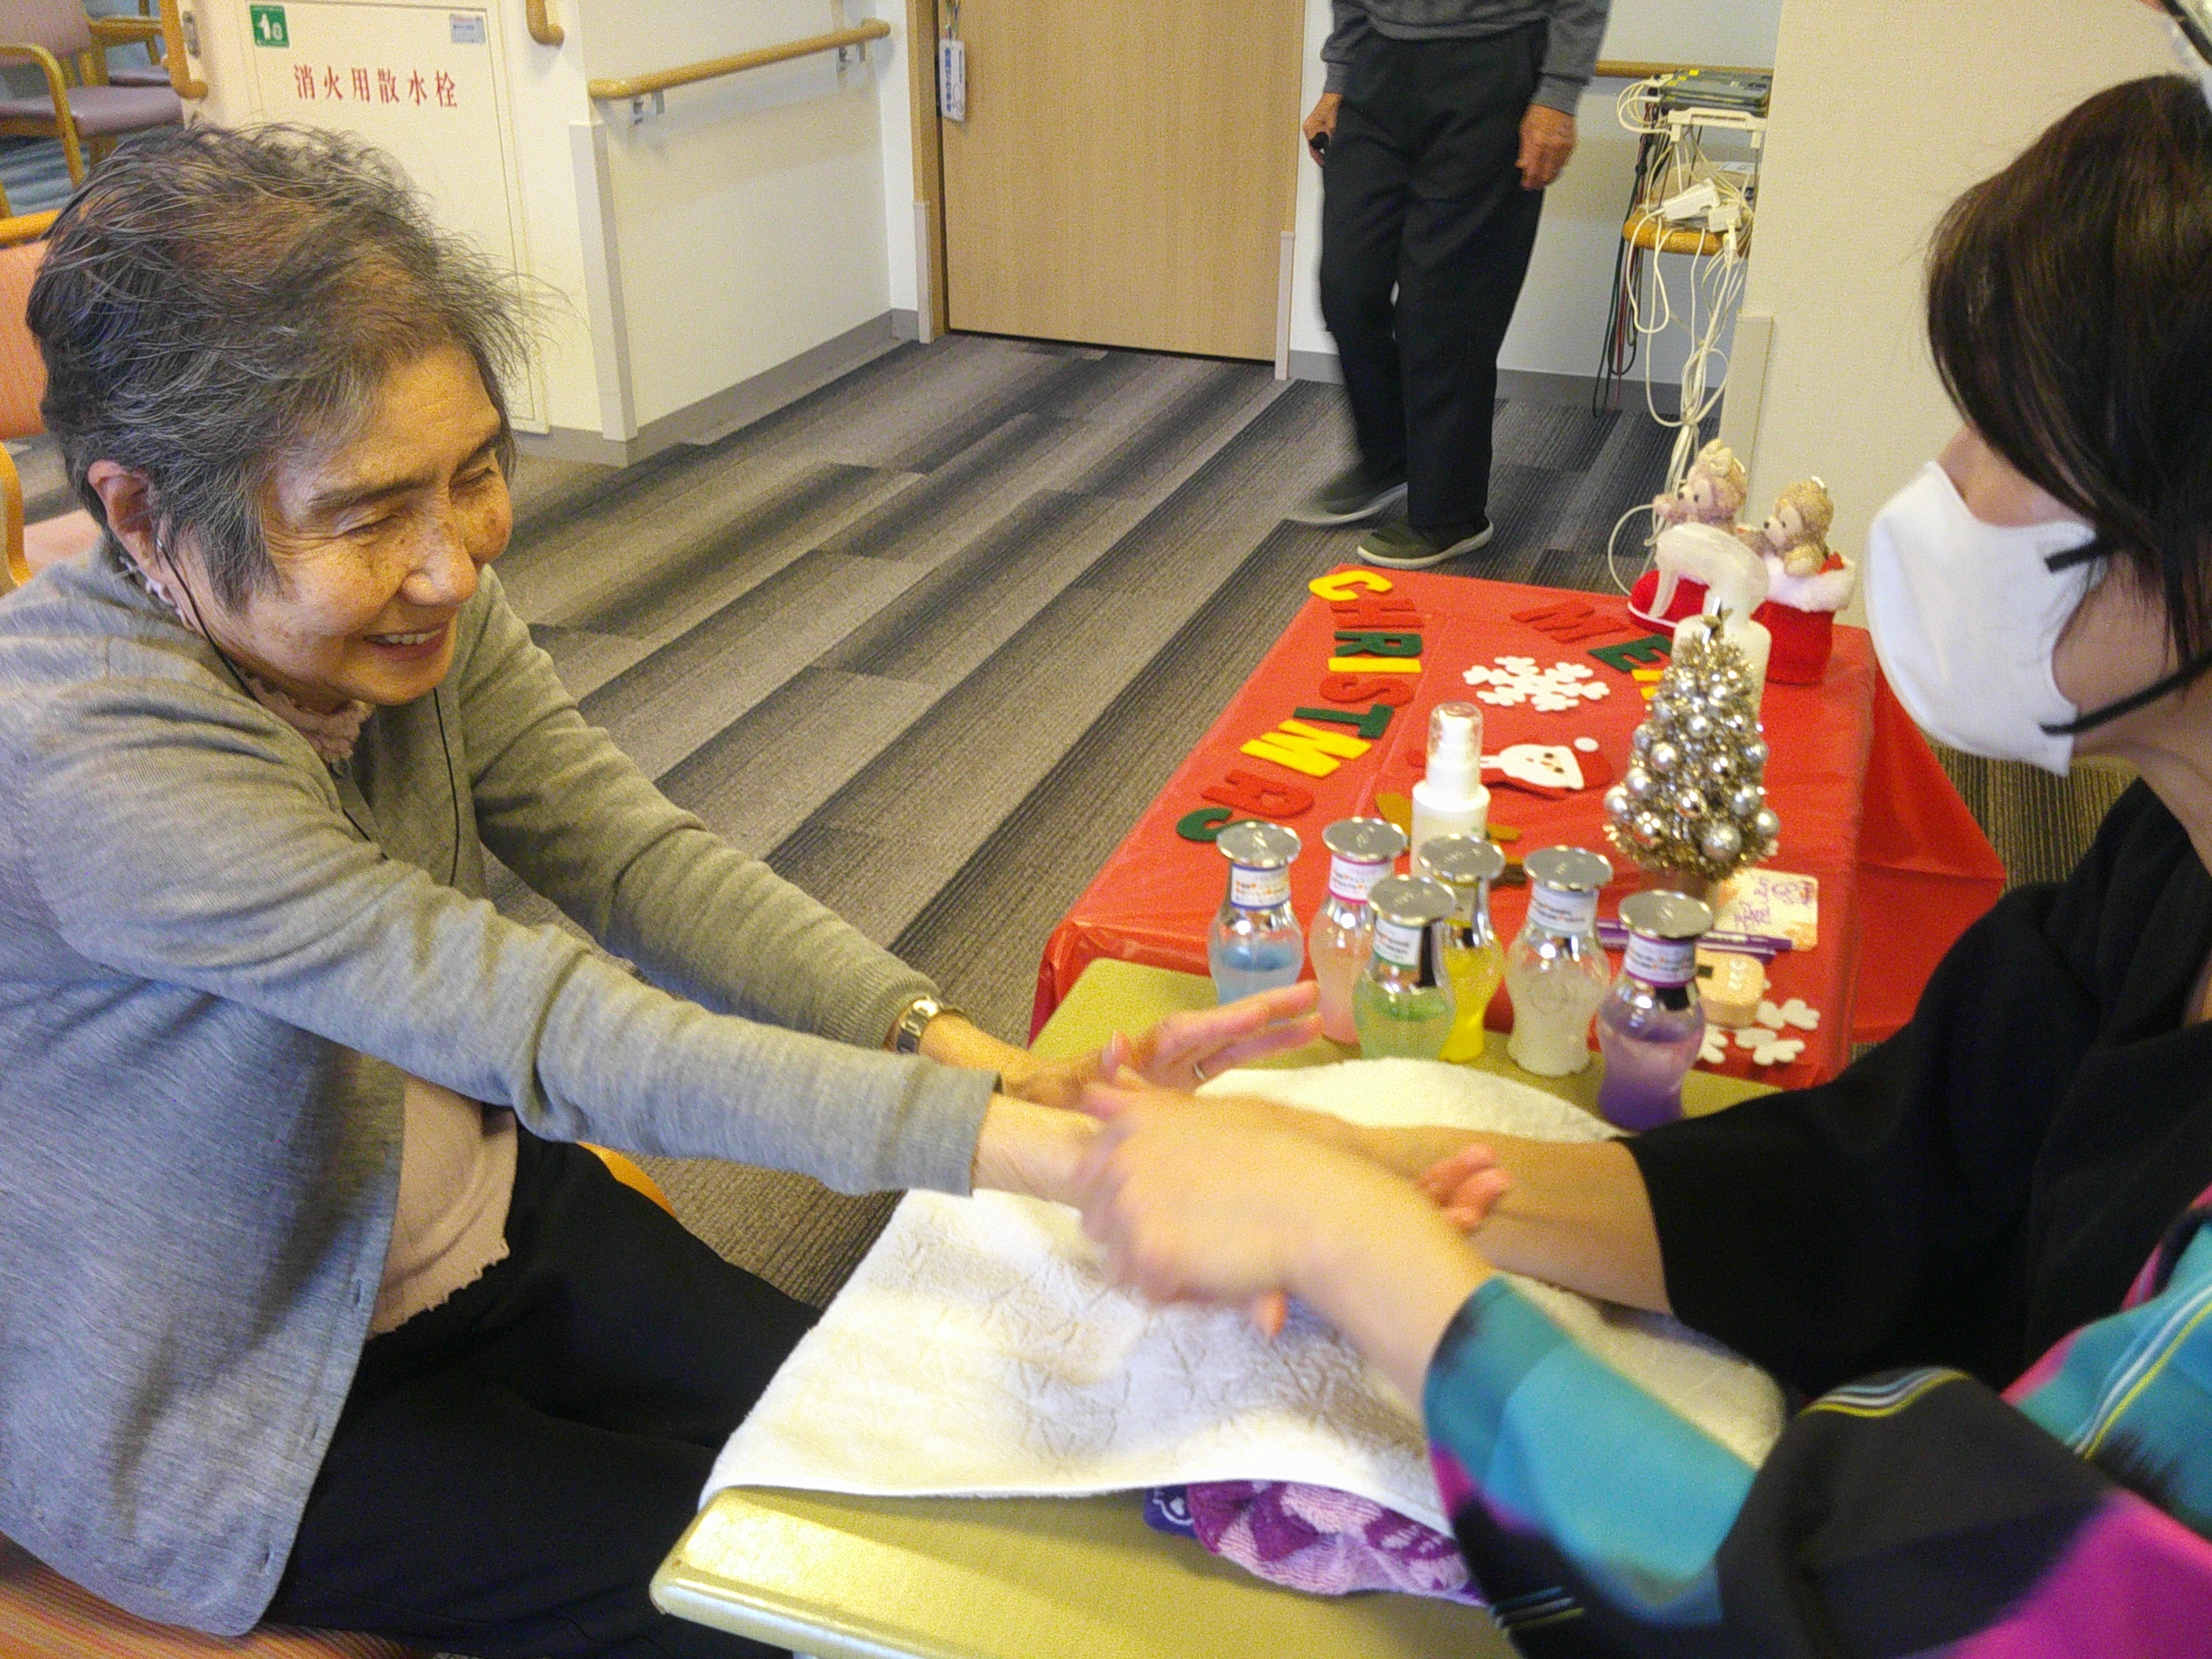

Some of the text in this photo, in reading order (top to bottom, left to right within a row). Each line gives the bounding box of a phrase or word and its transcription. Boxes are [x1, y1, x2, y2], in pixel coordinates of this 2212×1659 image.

[294, 64, 458, 107] 消火用散水栓
